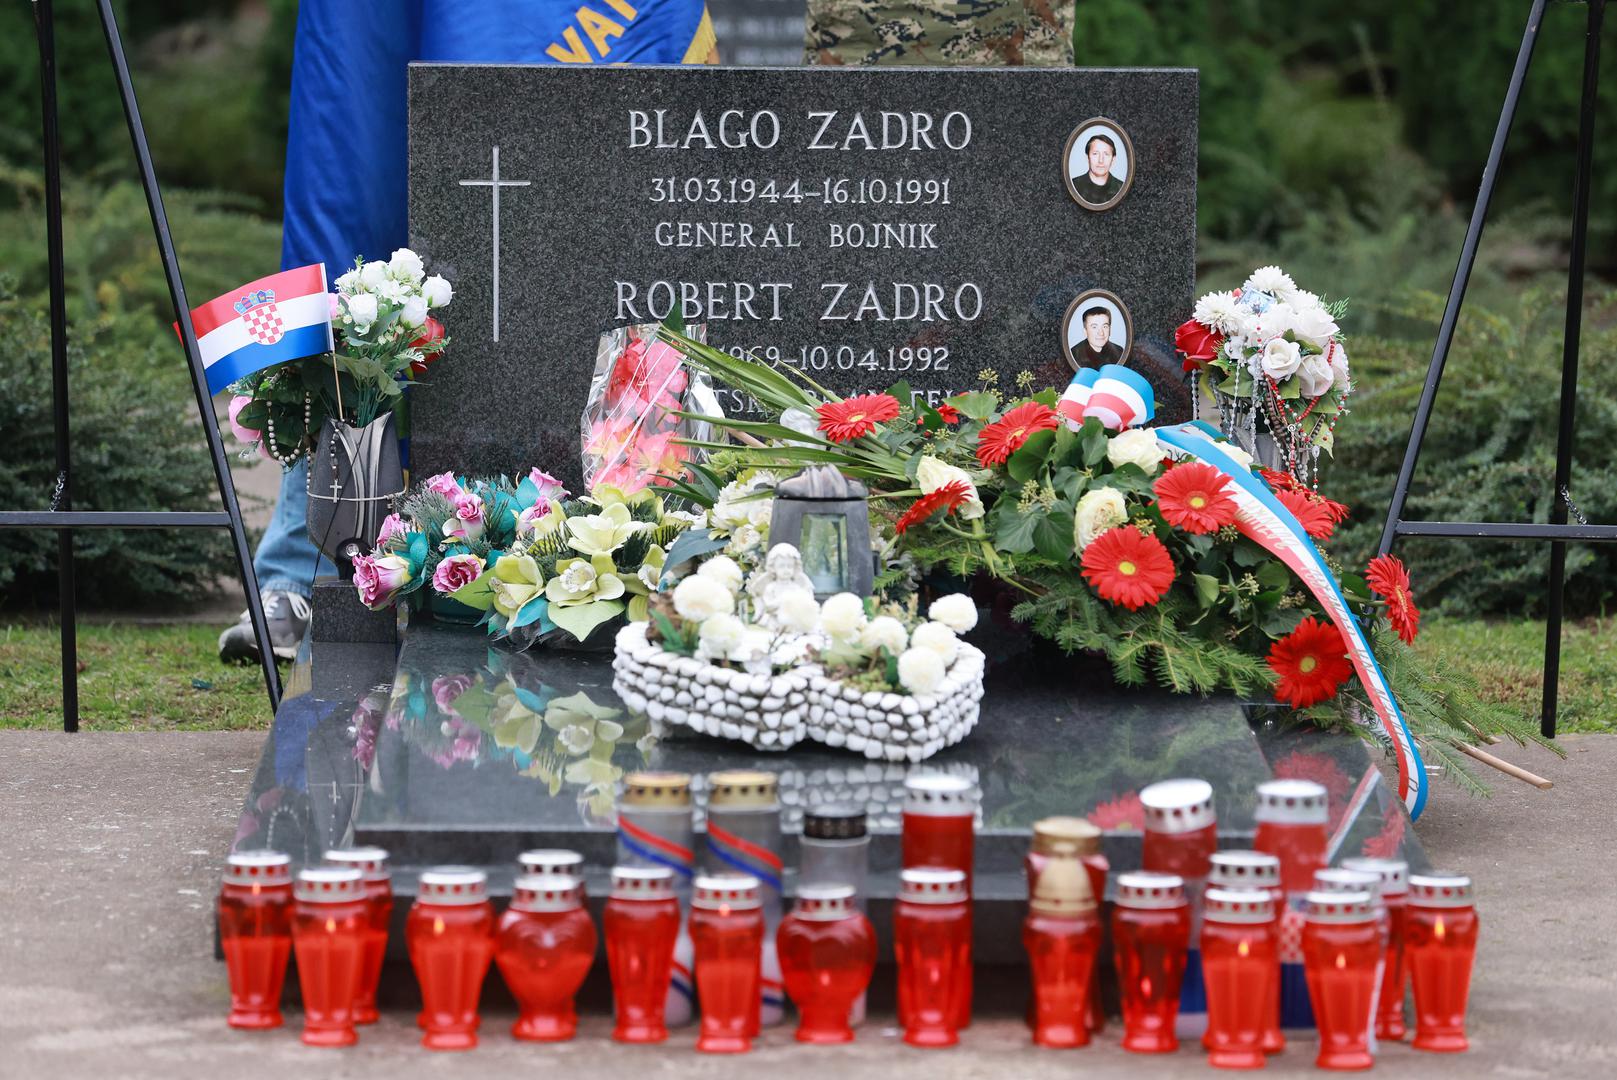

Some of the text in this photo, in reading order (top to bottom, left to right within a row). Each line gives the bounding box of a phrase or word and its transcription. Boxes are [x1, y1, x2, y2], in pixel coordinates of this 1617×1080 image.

[628, 109, 972, 150] BLAGO ZADRO
[655, 221, 939, 249] GENERAL BOJNIK
[614, 280, 983, 322] ROBERT ZADRO
